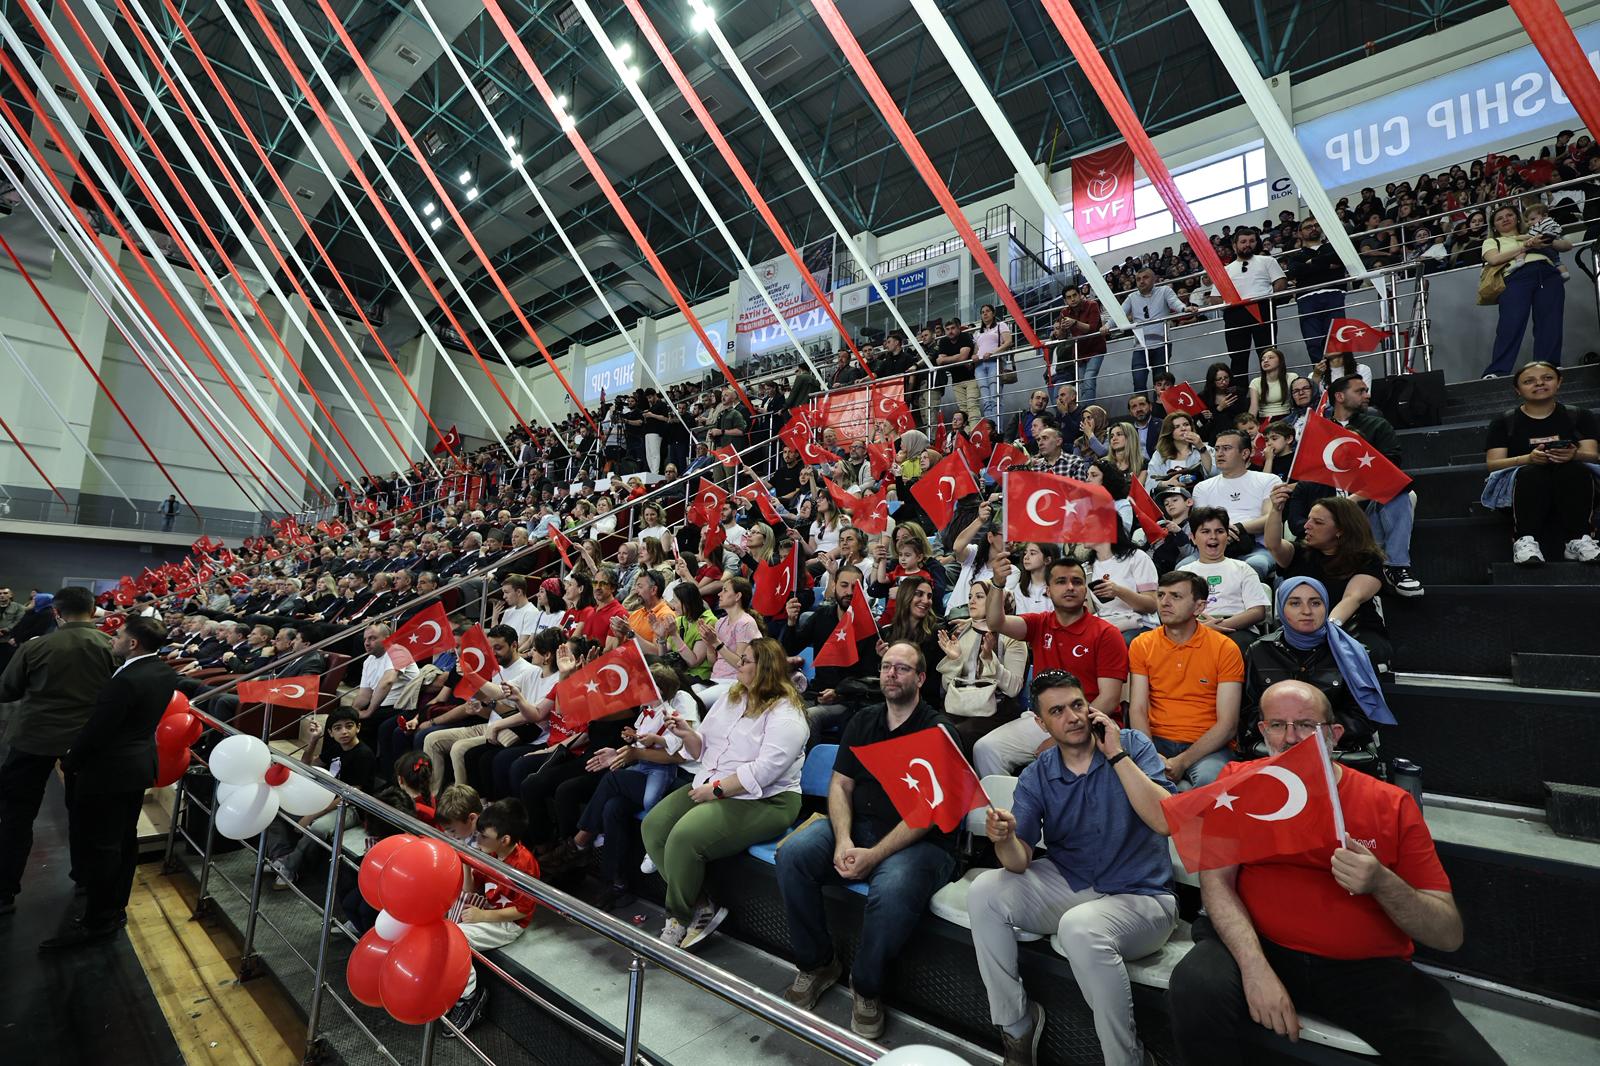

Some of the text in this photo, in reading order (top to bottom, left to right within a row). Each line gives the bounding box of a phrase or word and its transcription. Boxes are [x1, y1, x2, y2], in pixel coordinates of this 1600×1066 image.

[1271, 177, 1291, 191] C
[1271, 189, 1293, 200] BLOK
[1081, 198, 1125, 225] TVF
[900, 271, 924, 285] YAYIN
[727, 341, 735, 349] B
